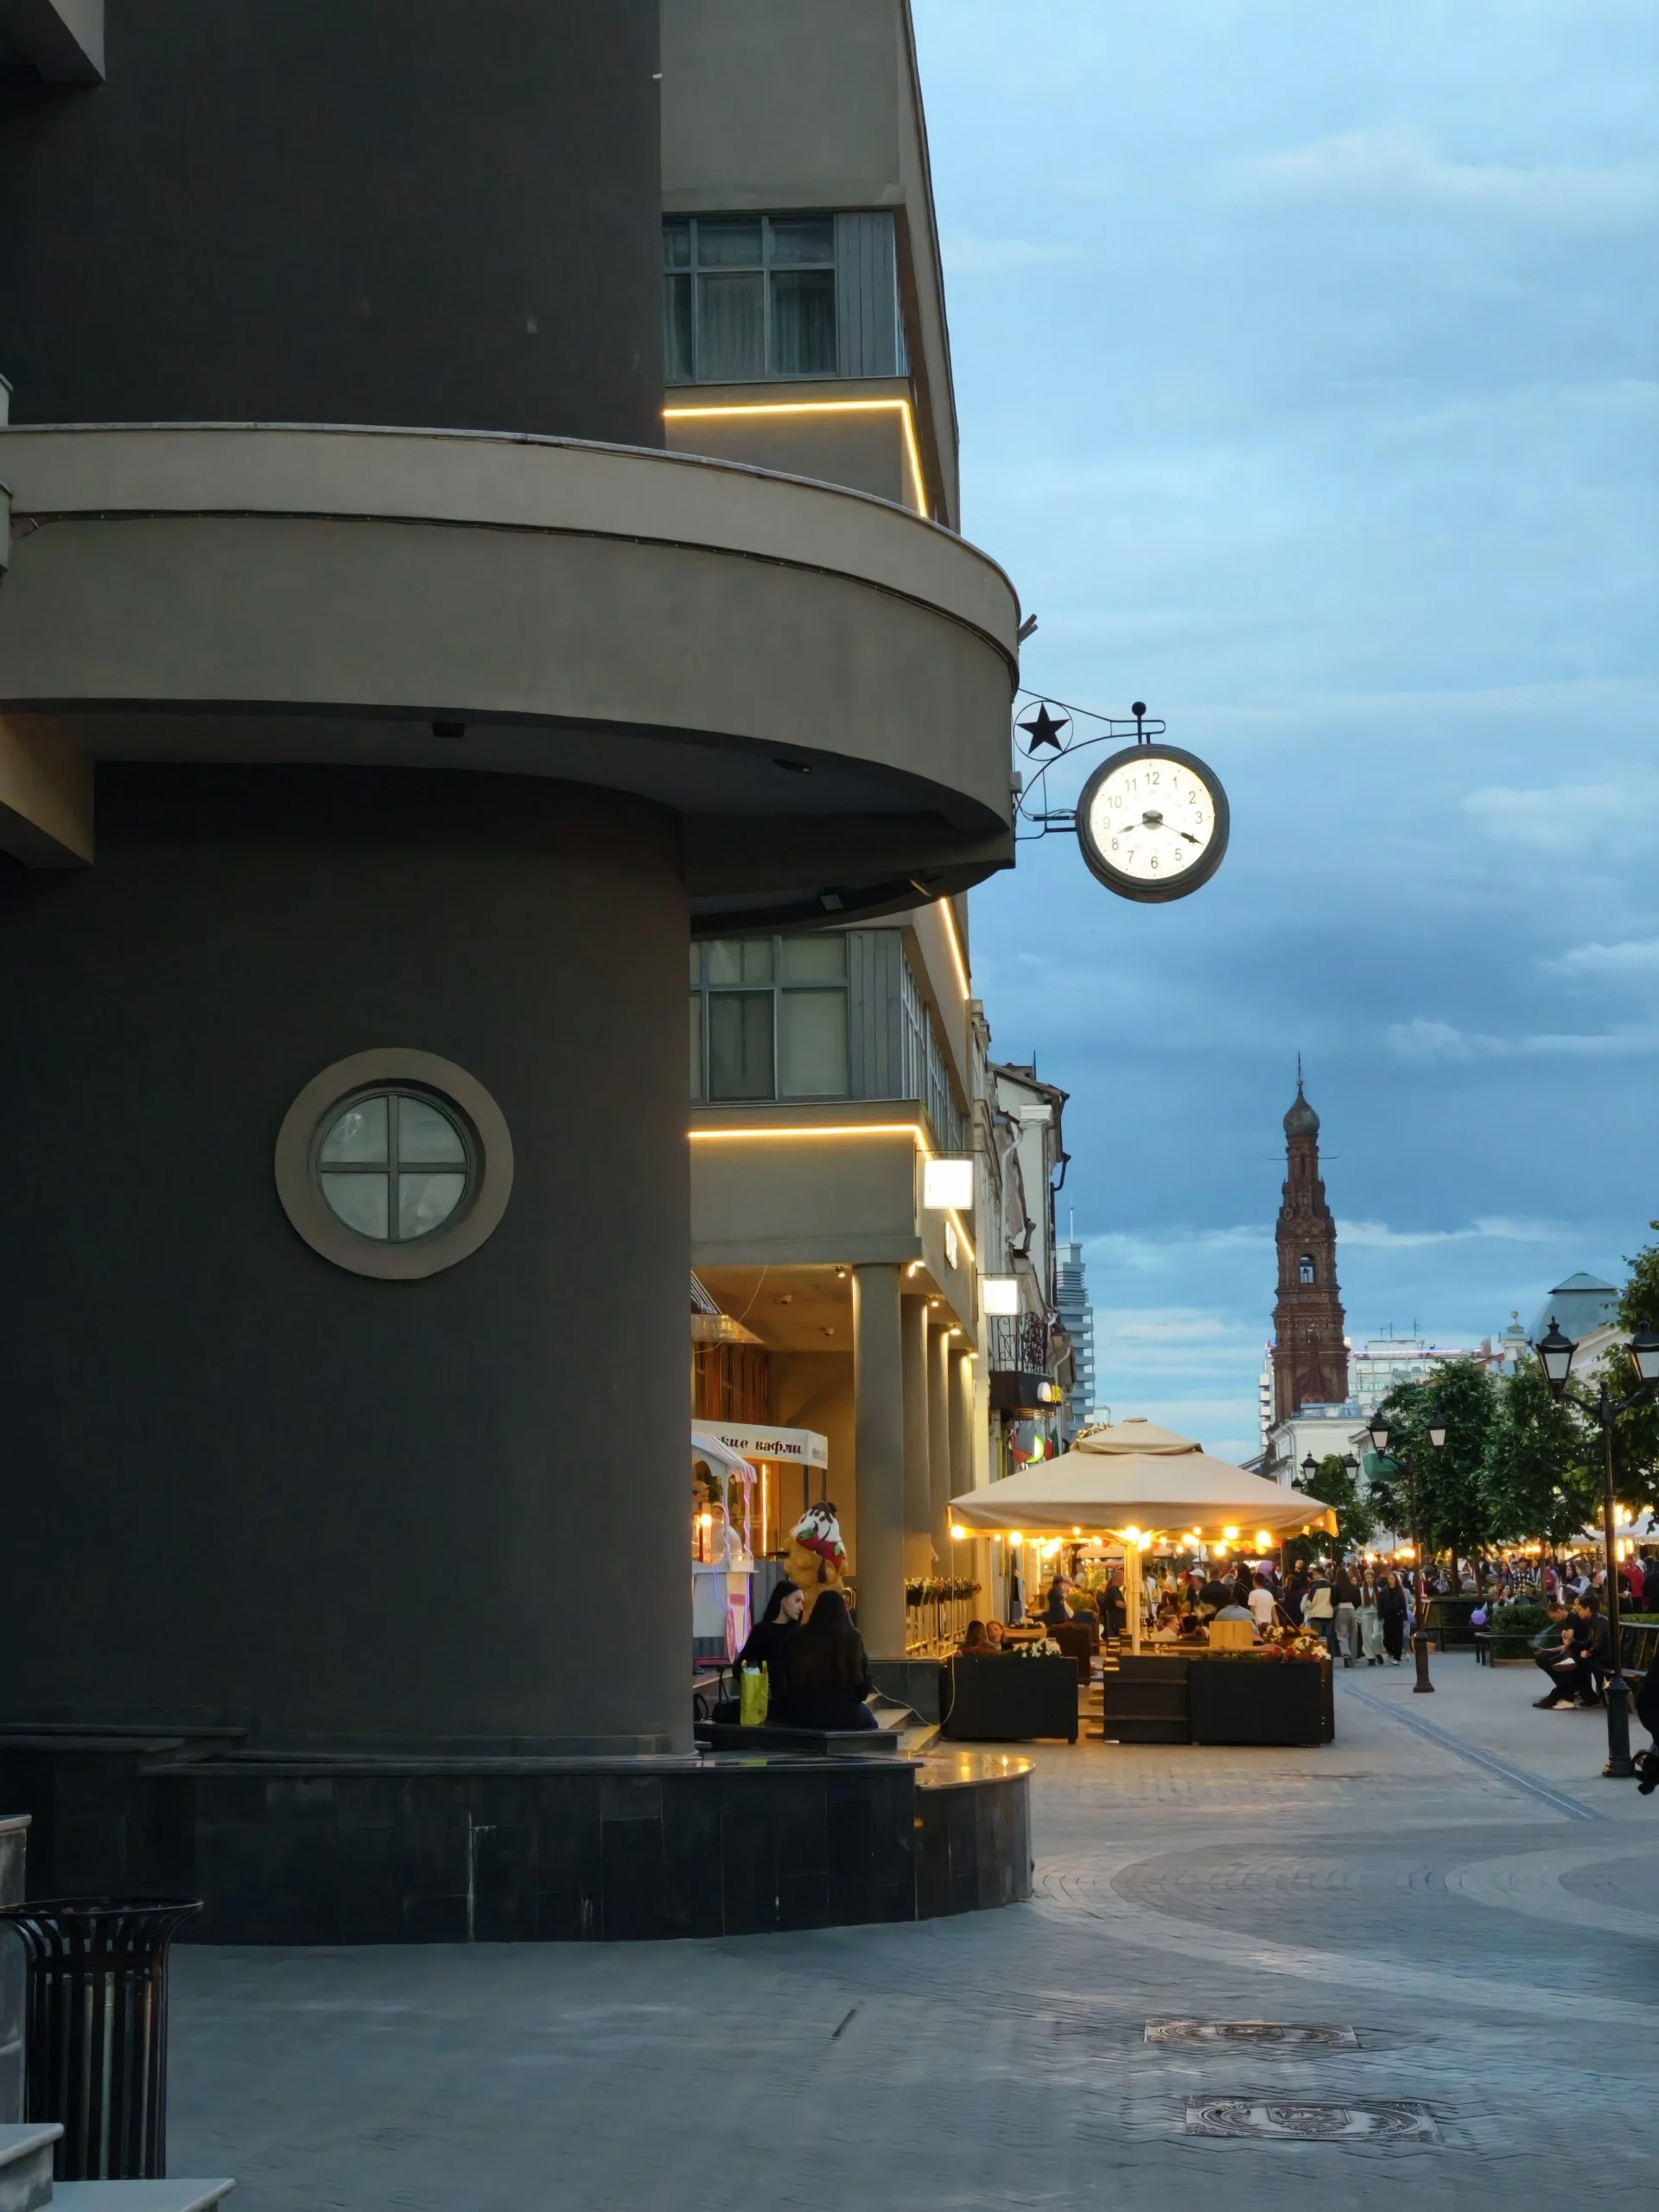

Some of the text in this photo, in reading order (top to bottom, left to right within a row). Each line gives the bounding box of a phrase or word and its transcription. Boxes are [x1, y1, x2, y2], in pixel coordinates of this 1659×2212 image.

[1124, 778, 1137, 792] 11
[1144, 772, 1160, 786] 12
[1107, 795, 1122, 809] 10
[1188, 791, 1197, 804] 2
[1103, 816, 1111, 830] 9
[1195, 810, 1204, 824] 3
[1111, 837, 1120, 851] 8
[1127, 850, 1135, 864] 7
[1174, 848, 1183, 861] 5
[1150, 855, 1159, 869] 6
[755, 1440, 803, 1454] вафли
